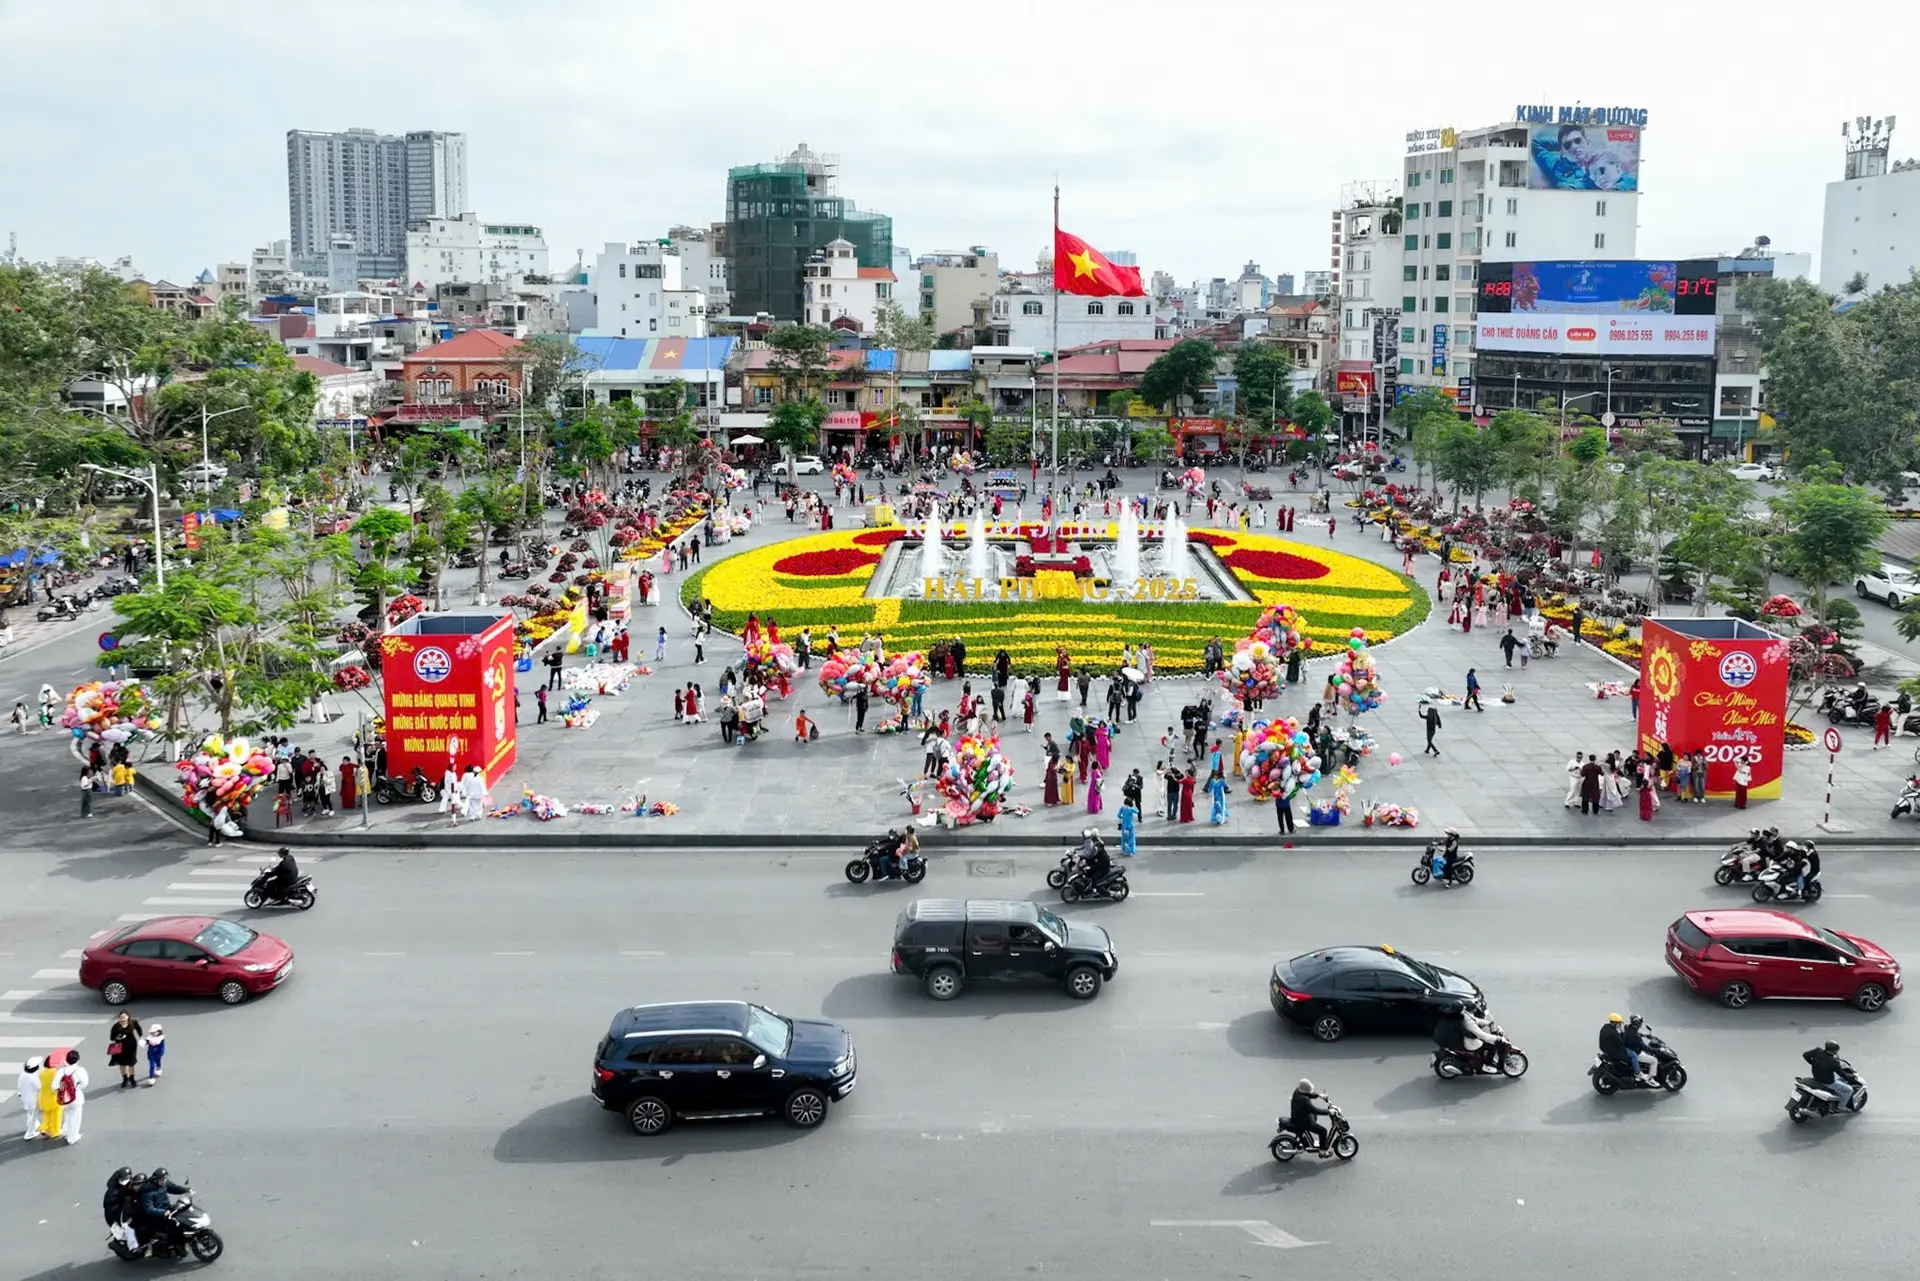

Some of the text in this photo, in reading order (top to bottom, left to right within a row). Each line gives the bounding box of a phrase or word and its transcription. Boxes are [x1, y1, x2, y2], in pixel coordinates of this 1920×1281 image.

[1482, 327, 1495, 338] CHO
[1497, 325, 1513, 338] THUÊ
[923, 570, 984, 599] HẢI
[1132, 577, 1198, 600] 2025
[392, 690, 476, 709] MỪNG ĐẢNG QUANG VINH
[1694, 691, 1757, 711] Chúc Mừng
[393, 713, 414, 730] MỪNG
[414, 711, 428, 730] ĐẤT
[429, 713, 448, 730] NƯỚC
[463, 713, 477, 730] MỚI
[1722, 709, 1749, 726] Năm
[404, 735, 424, 752] MỪNG
[425, 735, 445, 752] XUÂN
[1704, 744, 1763, 763] 2025
